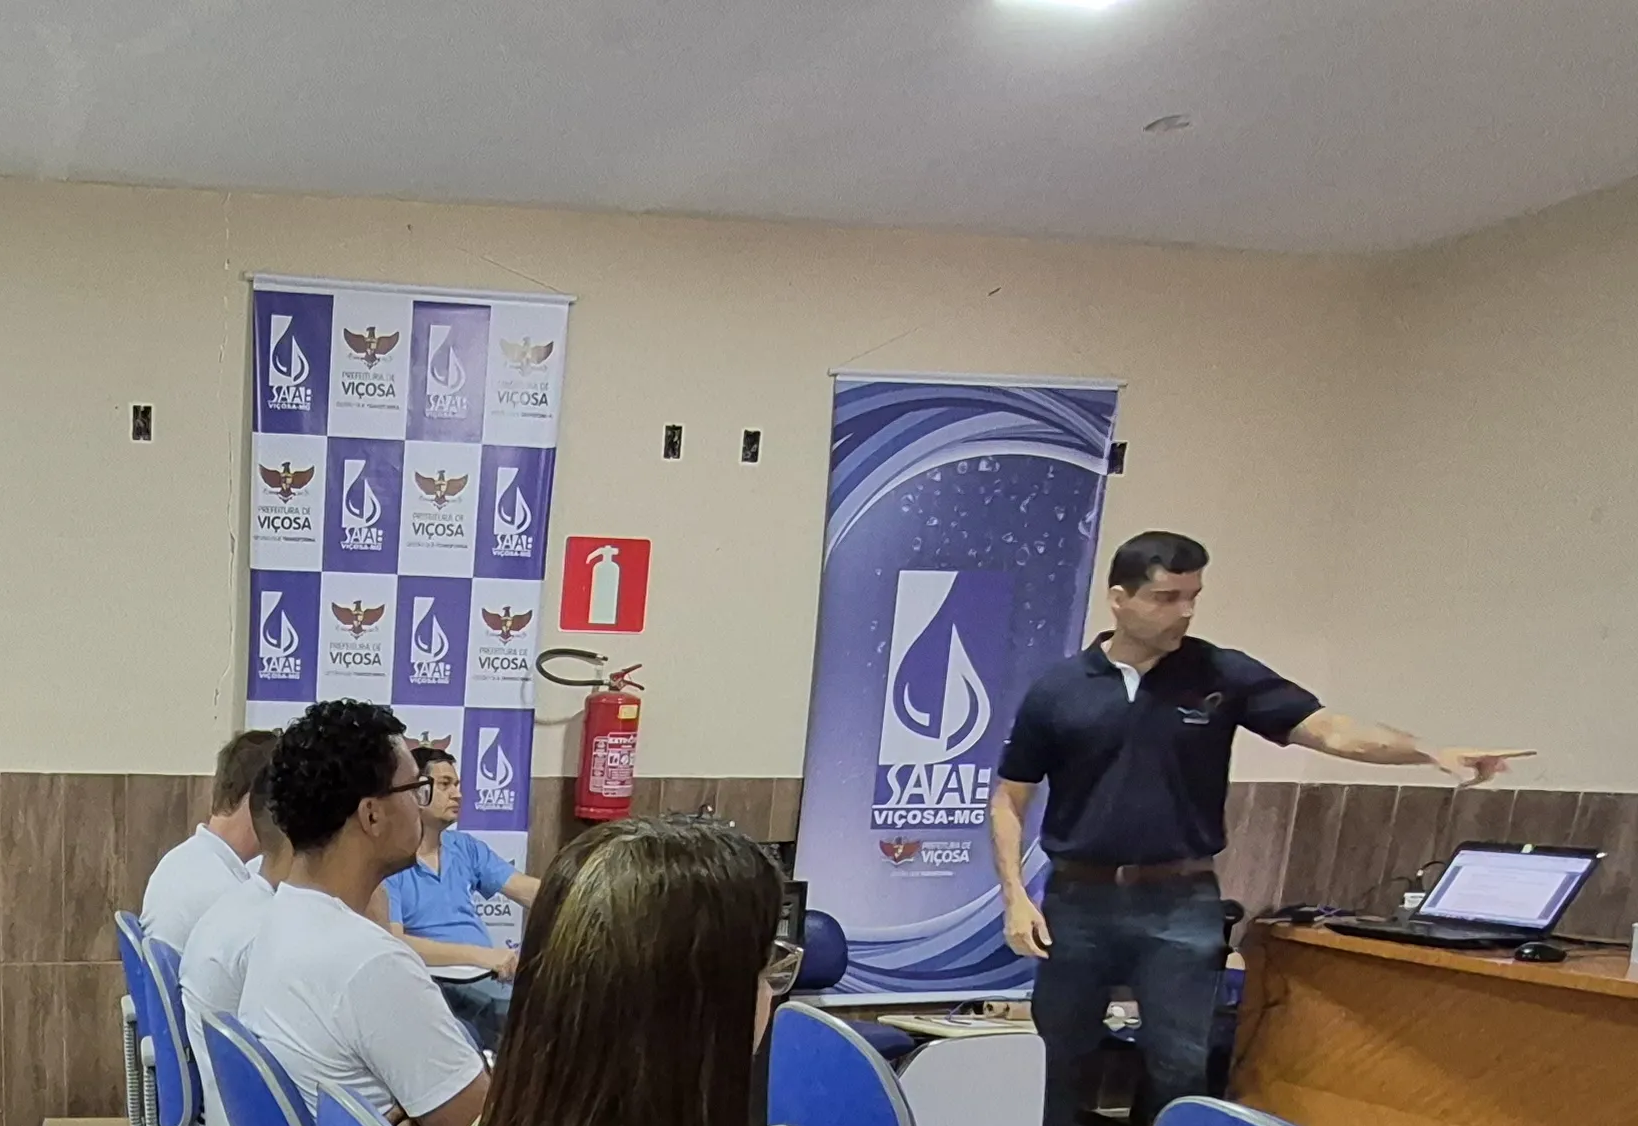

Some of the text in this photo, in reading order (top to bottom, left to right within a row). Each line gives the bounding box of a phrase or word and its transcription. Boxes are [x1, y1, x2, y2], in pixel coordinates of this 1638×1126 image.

[341, 381, 396, 399] VIÇOSA
[497, 390, 549, 408] VIÇOSA
[257, 515, 312, 533] VIÇOSA
[412, 522, 465, 539] VIÇOSA
[329, 652, 382, 668] VIÇOSA
[478, 657, 528, 672] VIÇOSA
[886, 764, 991, 806] SAAE
[873, 809, 985, 828] VIÇOSA-MG
[921, 850, 970, 867] VIÇOSA
